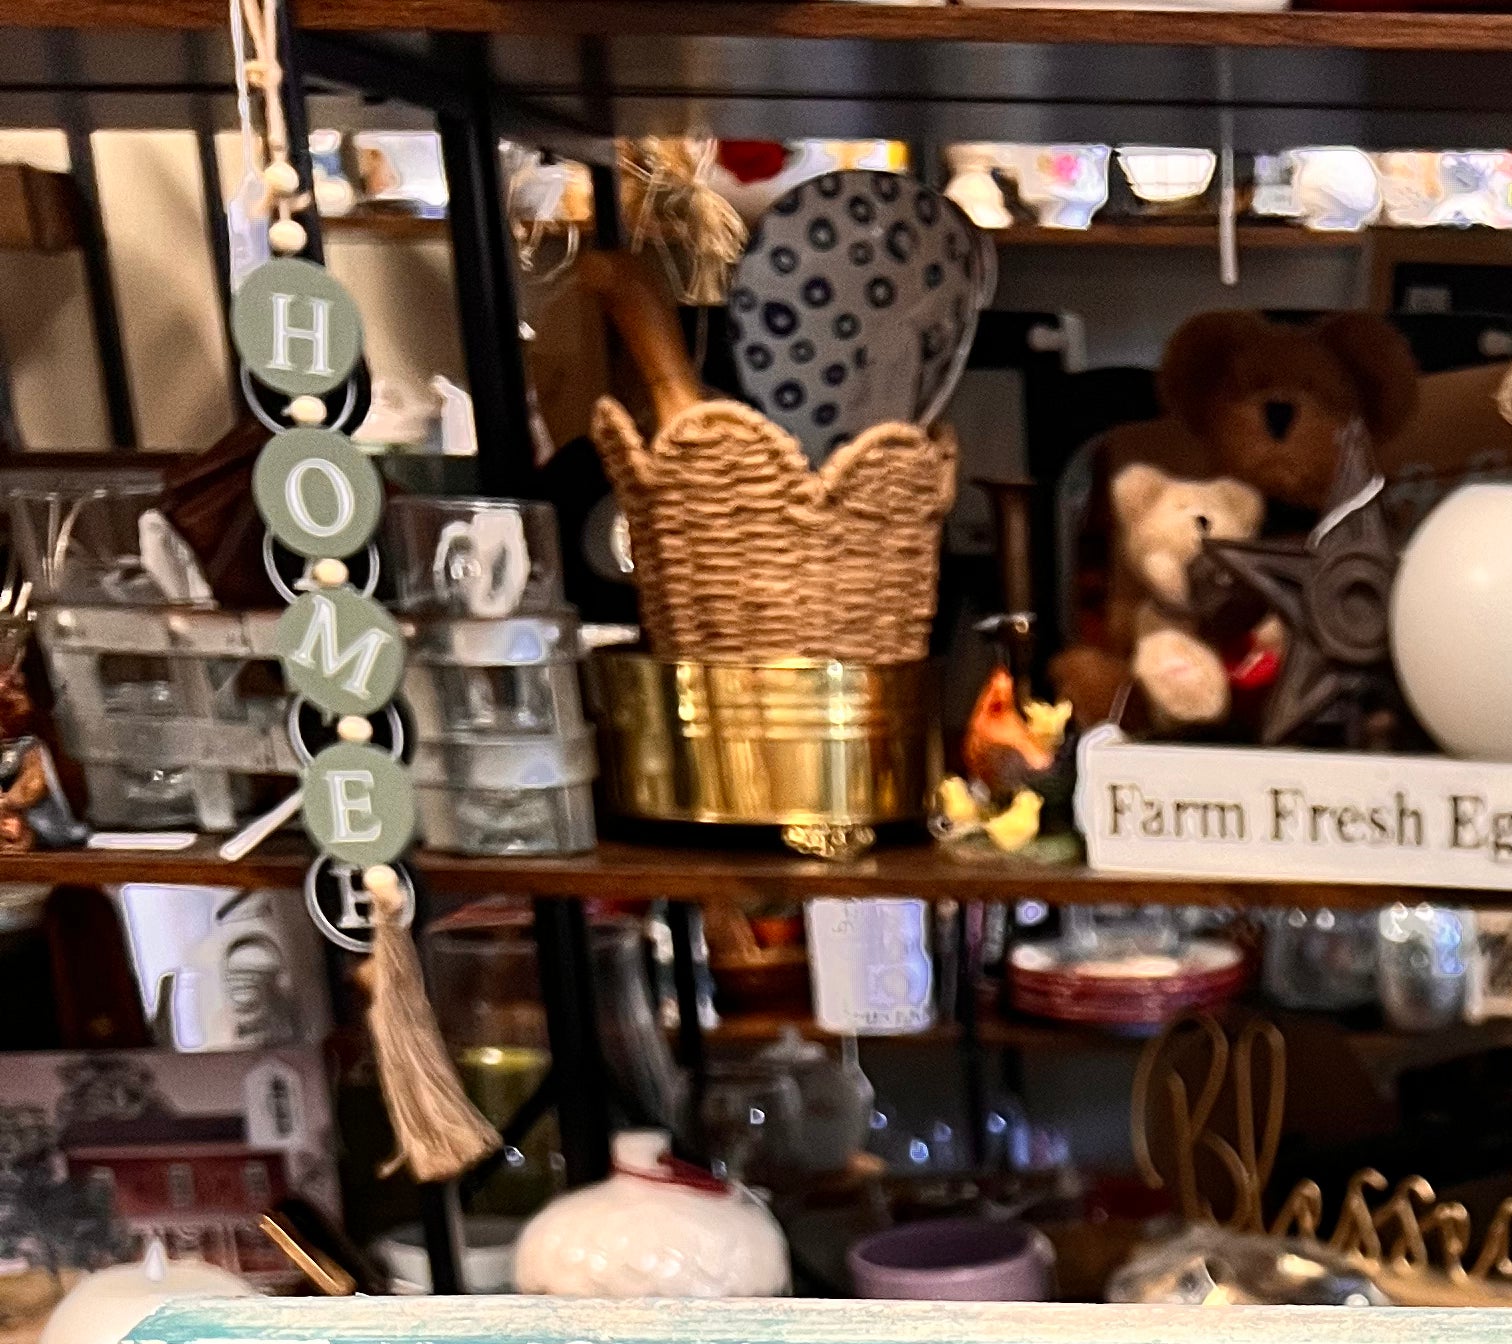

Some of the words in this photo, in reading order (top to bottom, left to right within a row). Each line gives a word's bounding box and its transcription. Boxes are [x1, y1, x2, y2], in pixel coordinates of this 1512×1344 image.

[262, 291, 392, 842] HOME
[1106, 782, 1247, 842] Farm
[1268, 787, 1427, 847] Fresh
